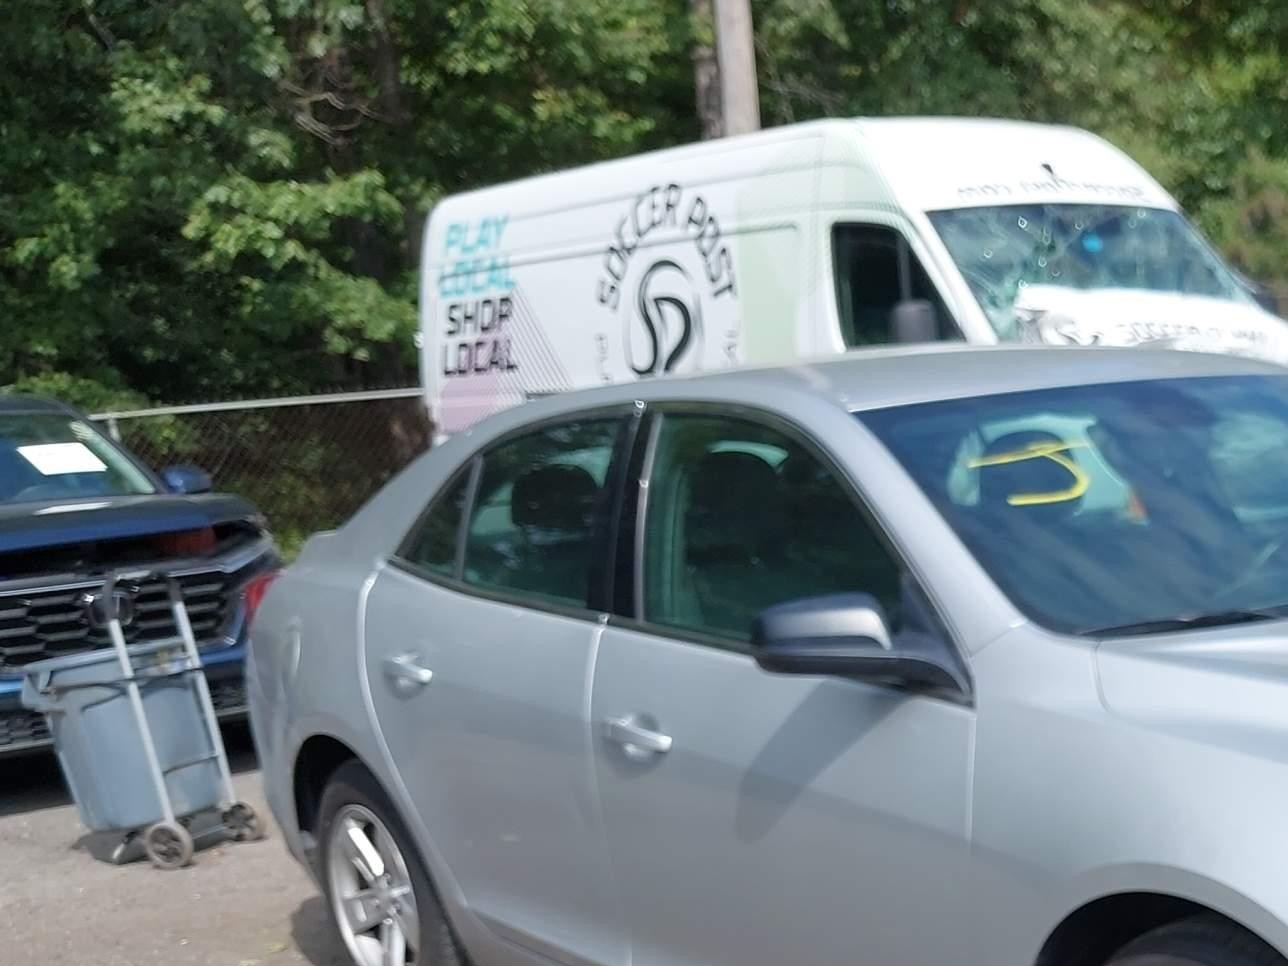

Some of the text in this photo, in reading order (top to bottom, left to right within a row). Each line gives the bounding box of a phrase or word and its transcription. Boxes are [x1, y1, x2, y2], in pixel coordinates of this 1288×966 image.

[445, 214, 511, 256] PLAY
[595, 183, 737, 312] SOCCER POST
[439, 256, 516, 297] LOCAL
[446, 296, 514, 337] SHOP
[443, 339, 519, 377] LOCAL
